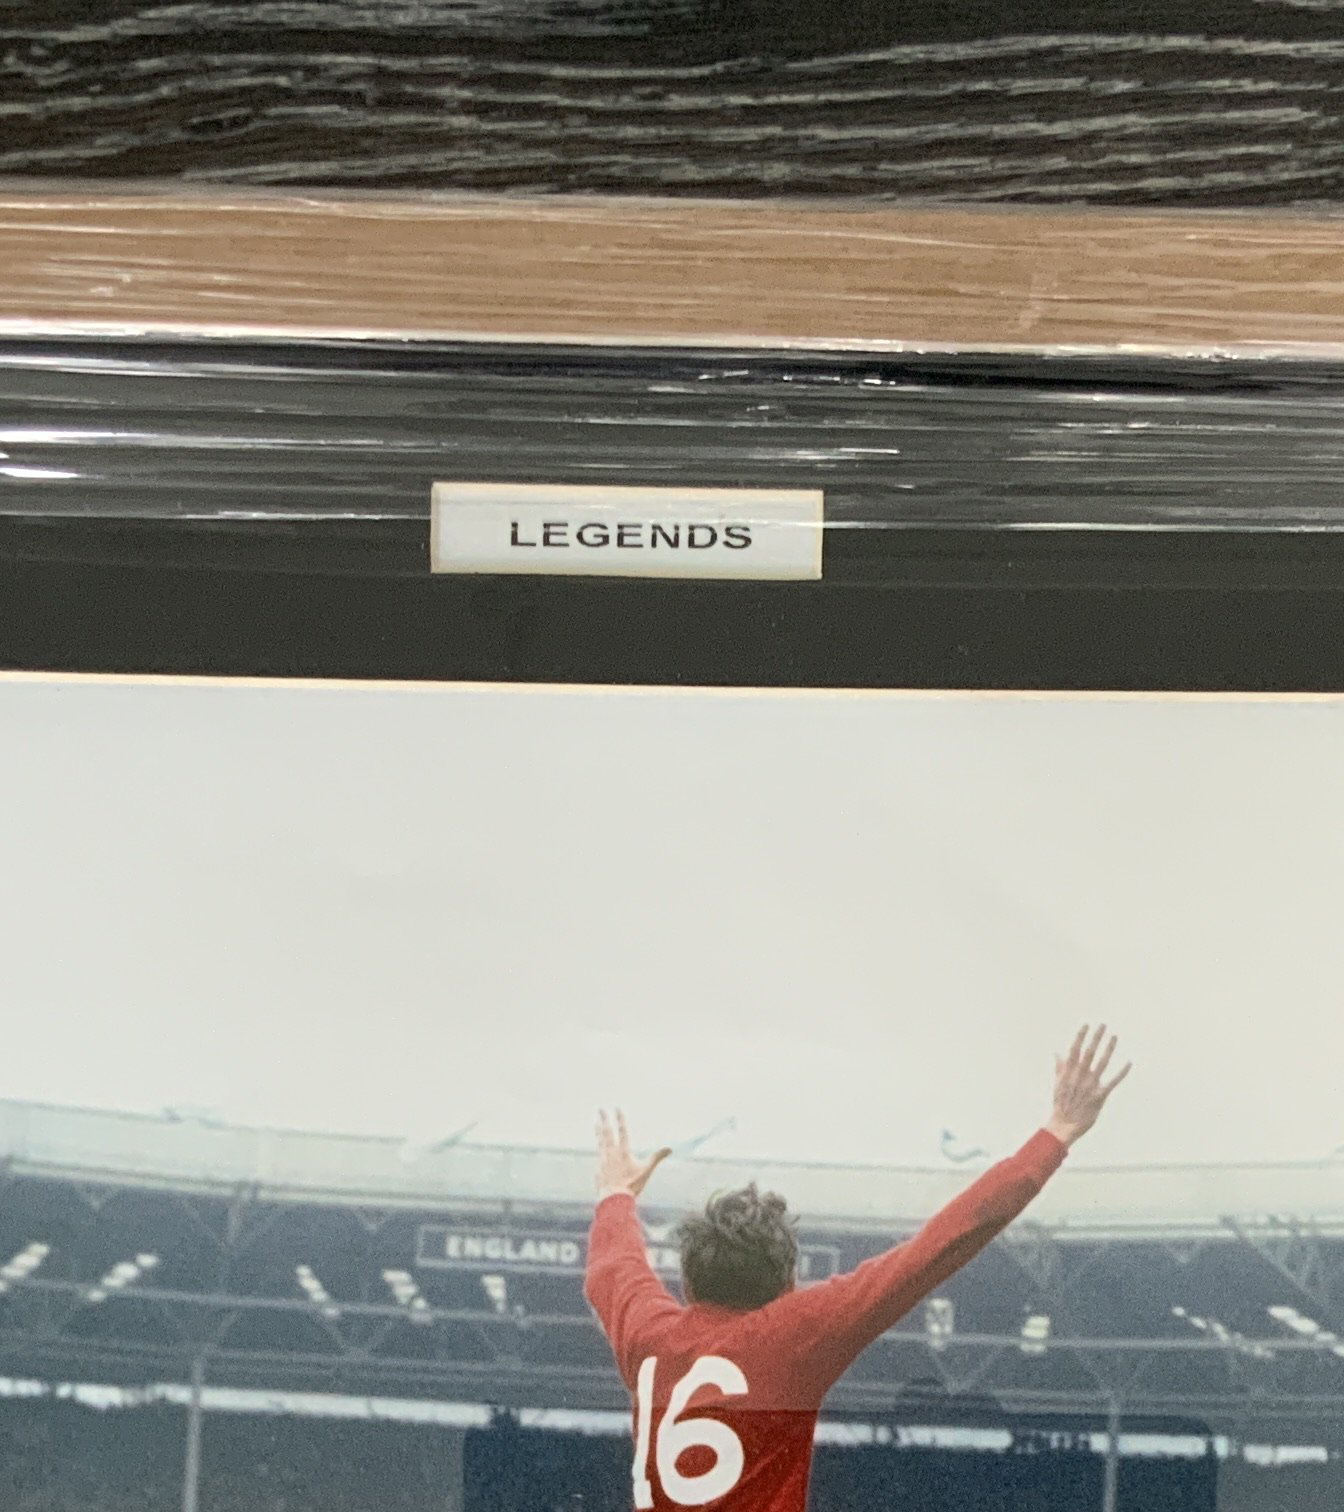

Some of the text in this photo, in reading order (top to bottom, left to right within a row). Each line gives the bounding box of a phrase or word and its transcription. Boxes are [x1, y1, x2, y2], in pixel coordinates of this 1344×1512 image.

[509, 521, 753, 549] LEGENDS
[446, 1235, 580, 1264] ENGLAND
[632, 1356, 749, 1509] 16
